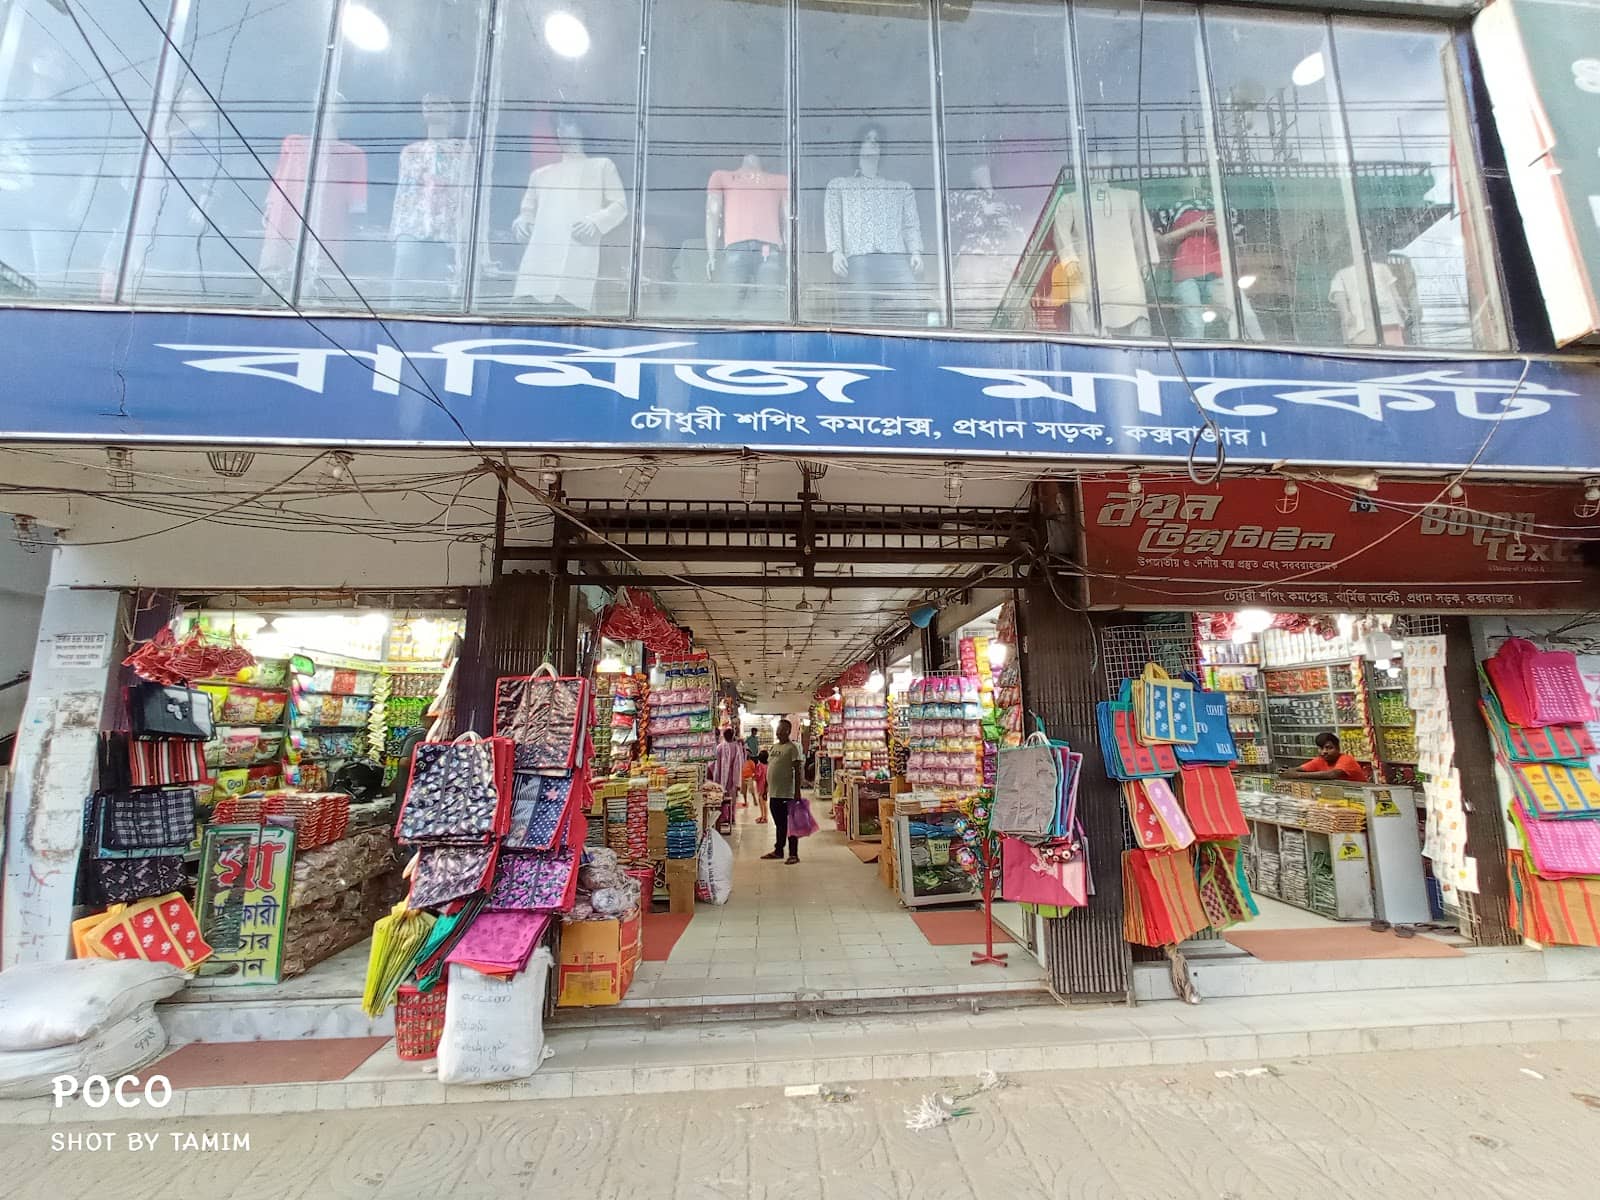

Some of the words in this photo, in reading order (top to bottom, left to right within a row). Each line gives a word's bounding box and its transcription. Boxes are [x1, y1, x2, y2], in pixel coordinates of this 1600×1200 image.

[152, 338, 895, 403] বার্মিজ
[938, 366, 1581, 421] মার্কেট
[631, 405, 726, 435] চৌধুরী
[733, 407, 810, 434] শপিং
[816, 415, 942, 440] কমপ্লেক্স,
[952, 418, 1026, 438] প্রধান
[1032, 422, 1113, 445] সড়ক,
[1138, 522, 1336, 556] টেক্সটাইল
